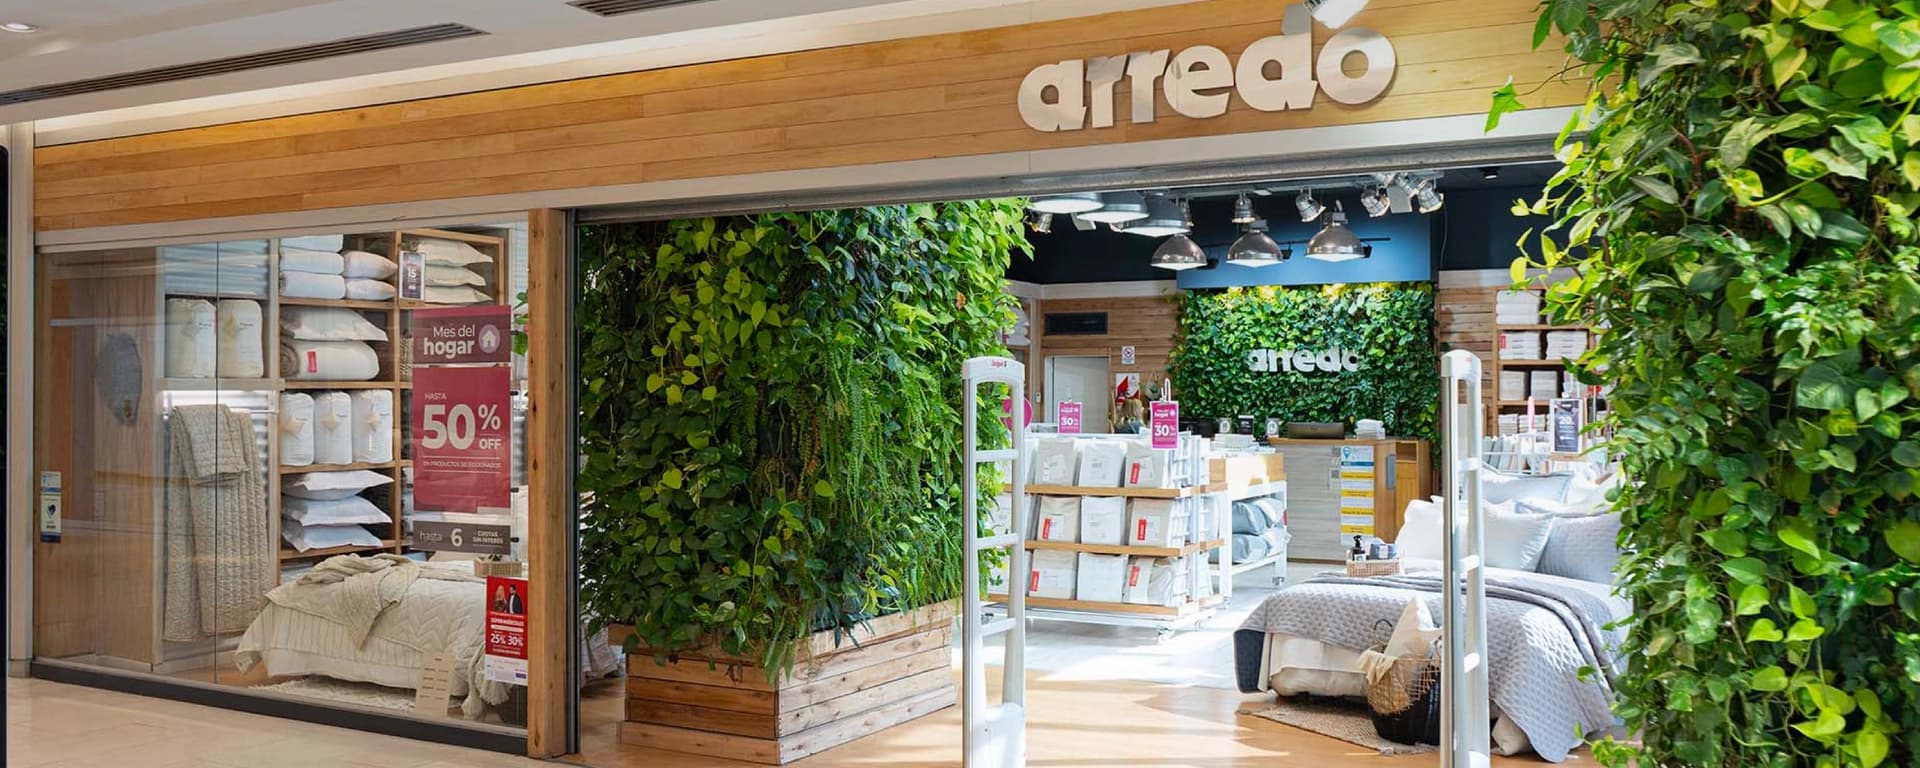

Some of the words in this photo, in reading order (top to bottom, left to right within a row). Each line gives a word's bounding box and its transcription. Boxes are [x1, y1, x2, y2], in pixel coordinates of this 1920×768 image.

[1017, 3, 1396, 132] arredo
[433, 326, 456, 338] Mes
[458, 324, 475, 337] del
[423, 337, 475, 359] hogar
[479, 439, 501, 450] OFF
[420, 531, 442, 541] hasta
[451, 528, 463, 547] 6
